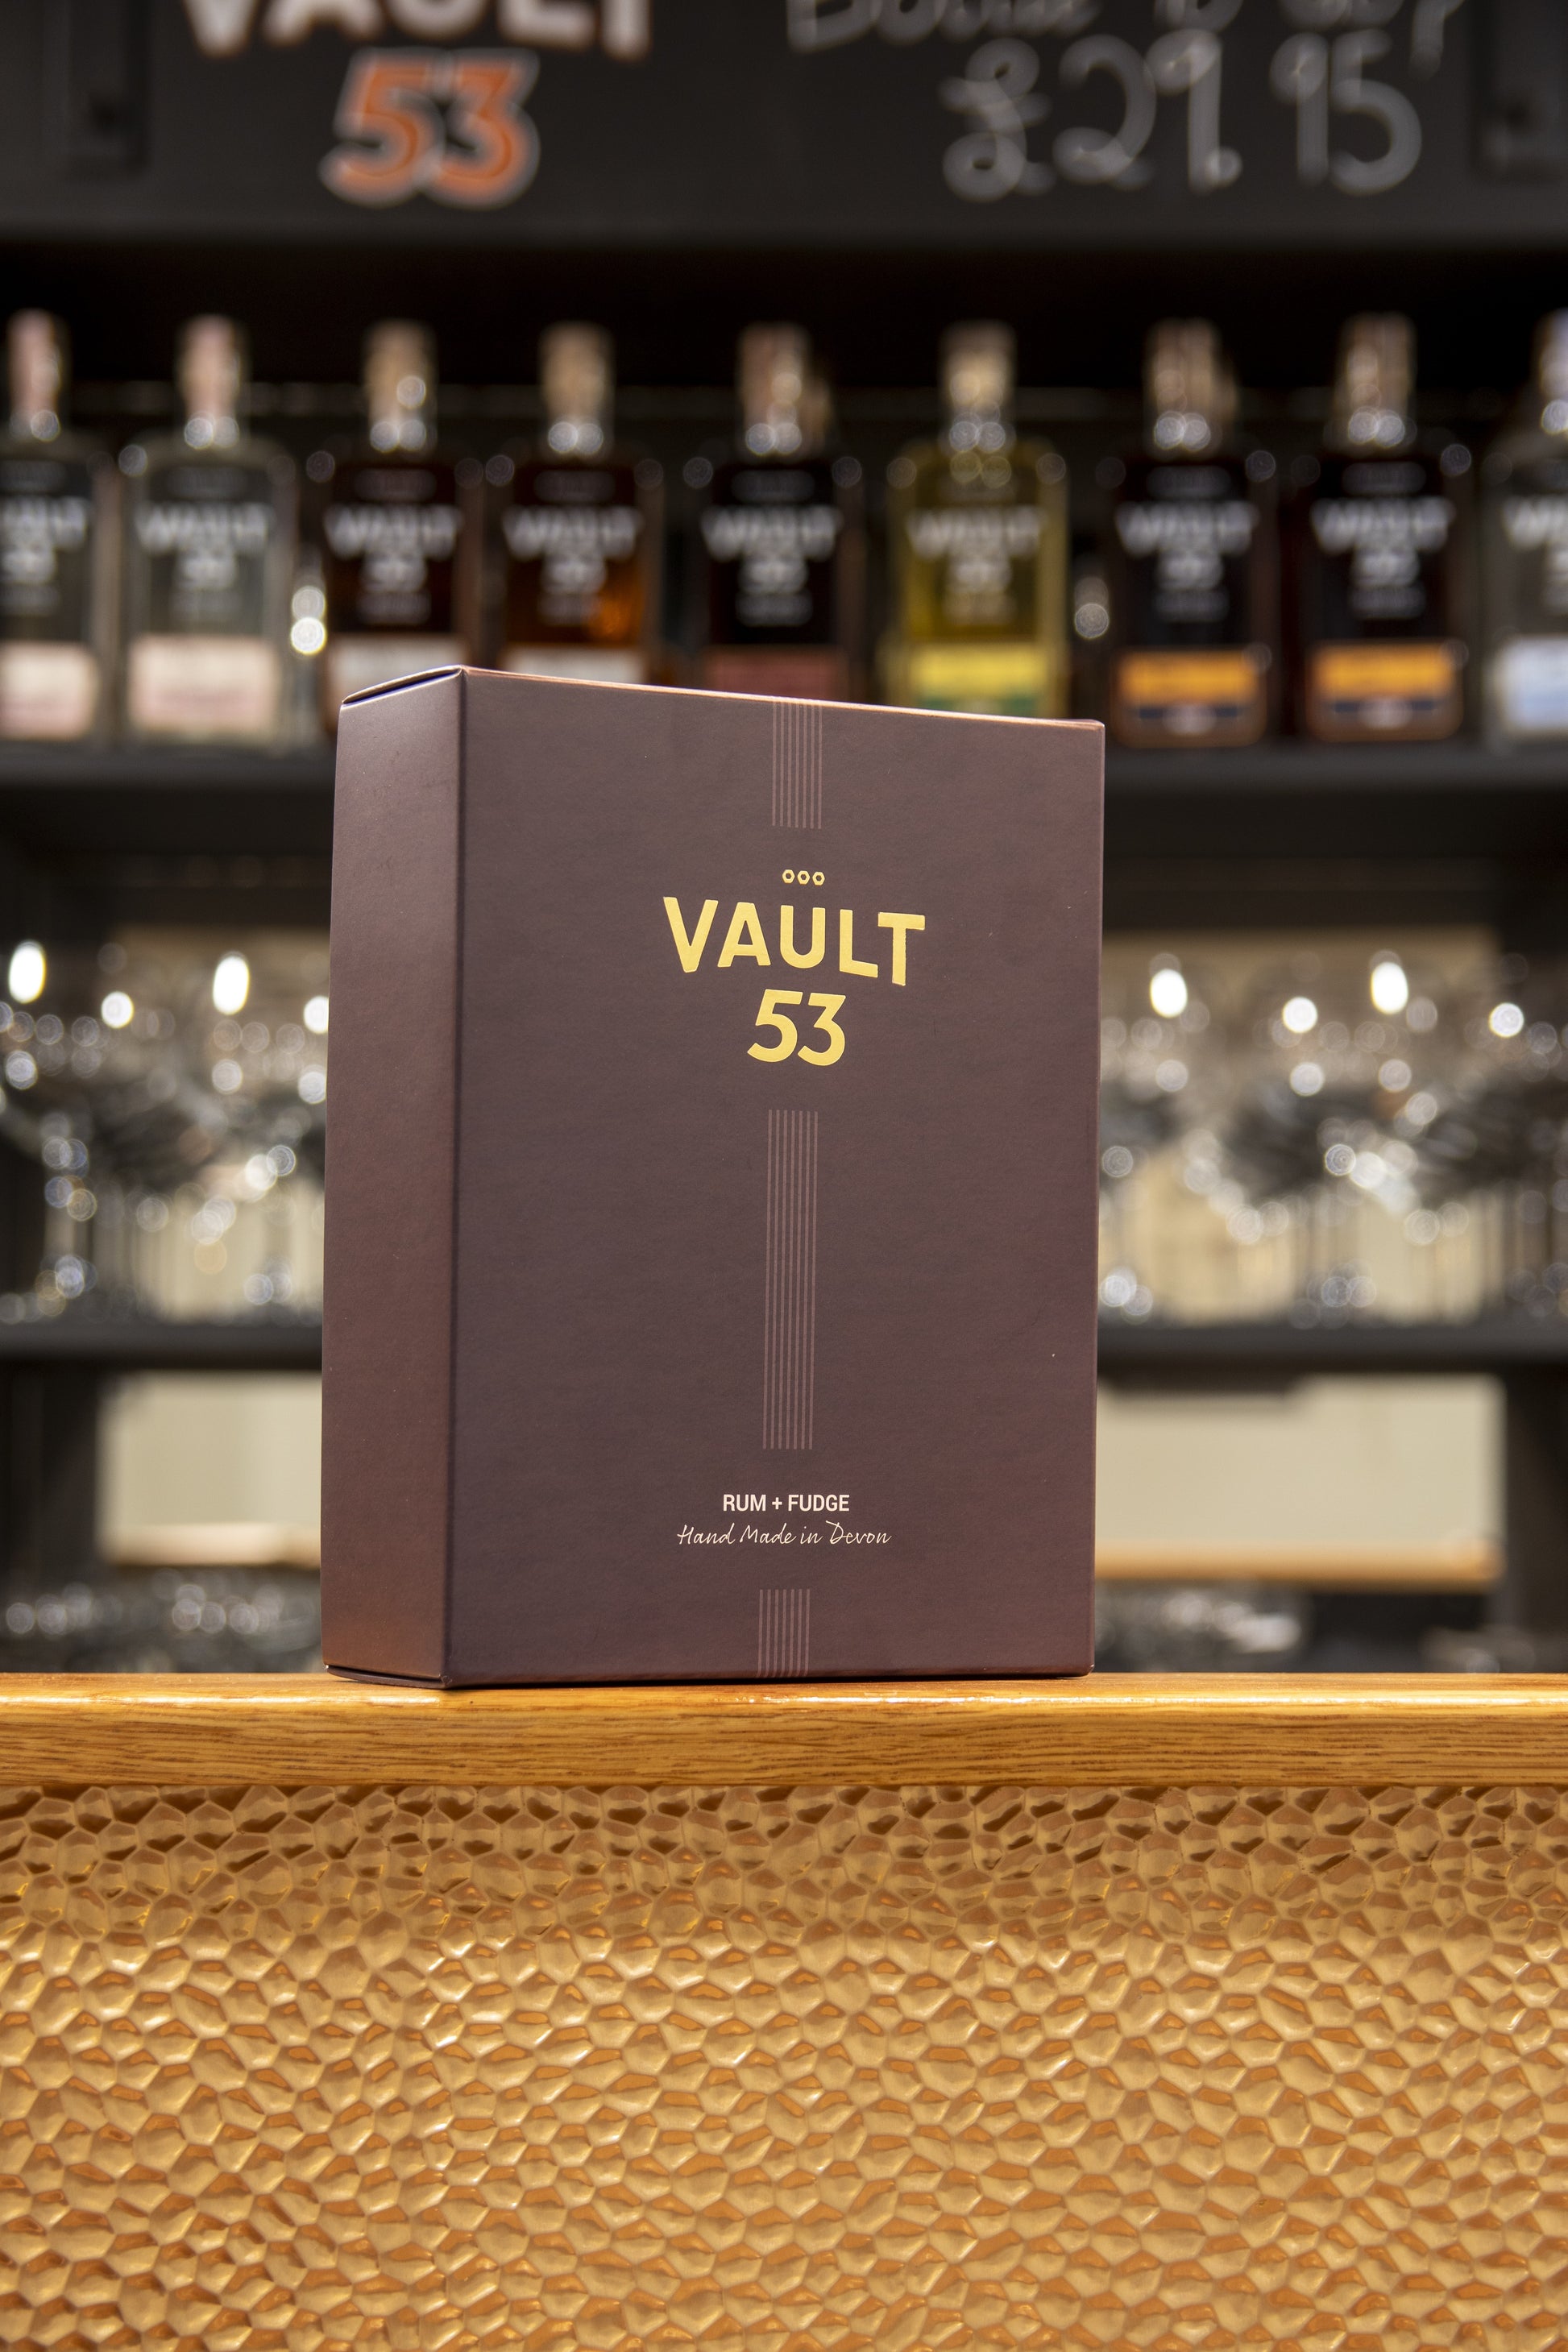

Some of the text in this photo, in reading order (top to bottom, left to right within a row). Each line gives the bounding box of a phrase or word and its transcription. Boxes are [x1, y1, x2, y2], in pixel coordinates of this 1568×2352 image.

[320, 47, 540, 209] 53
[663, 896, 926, 986] VAULT
[747, 989, 846, 1066] 53
[677, 1520, 892, 1545] Hand Made in Devon
[723, 1494, 850, 1512] RUM + FUDGE
